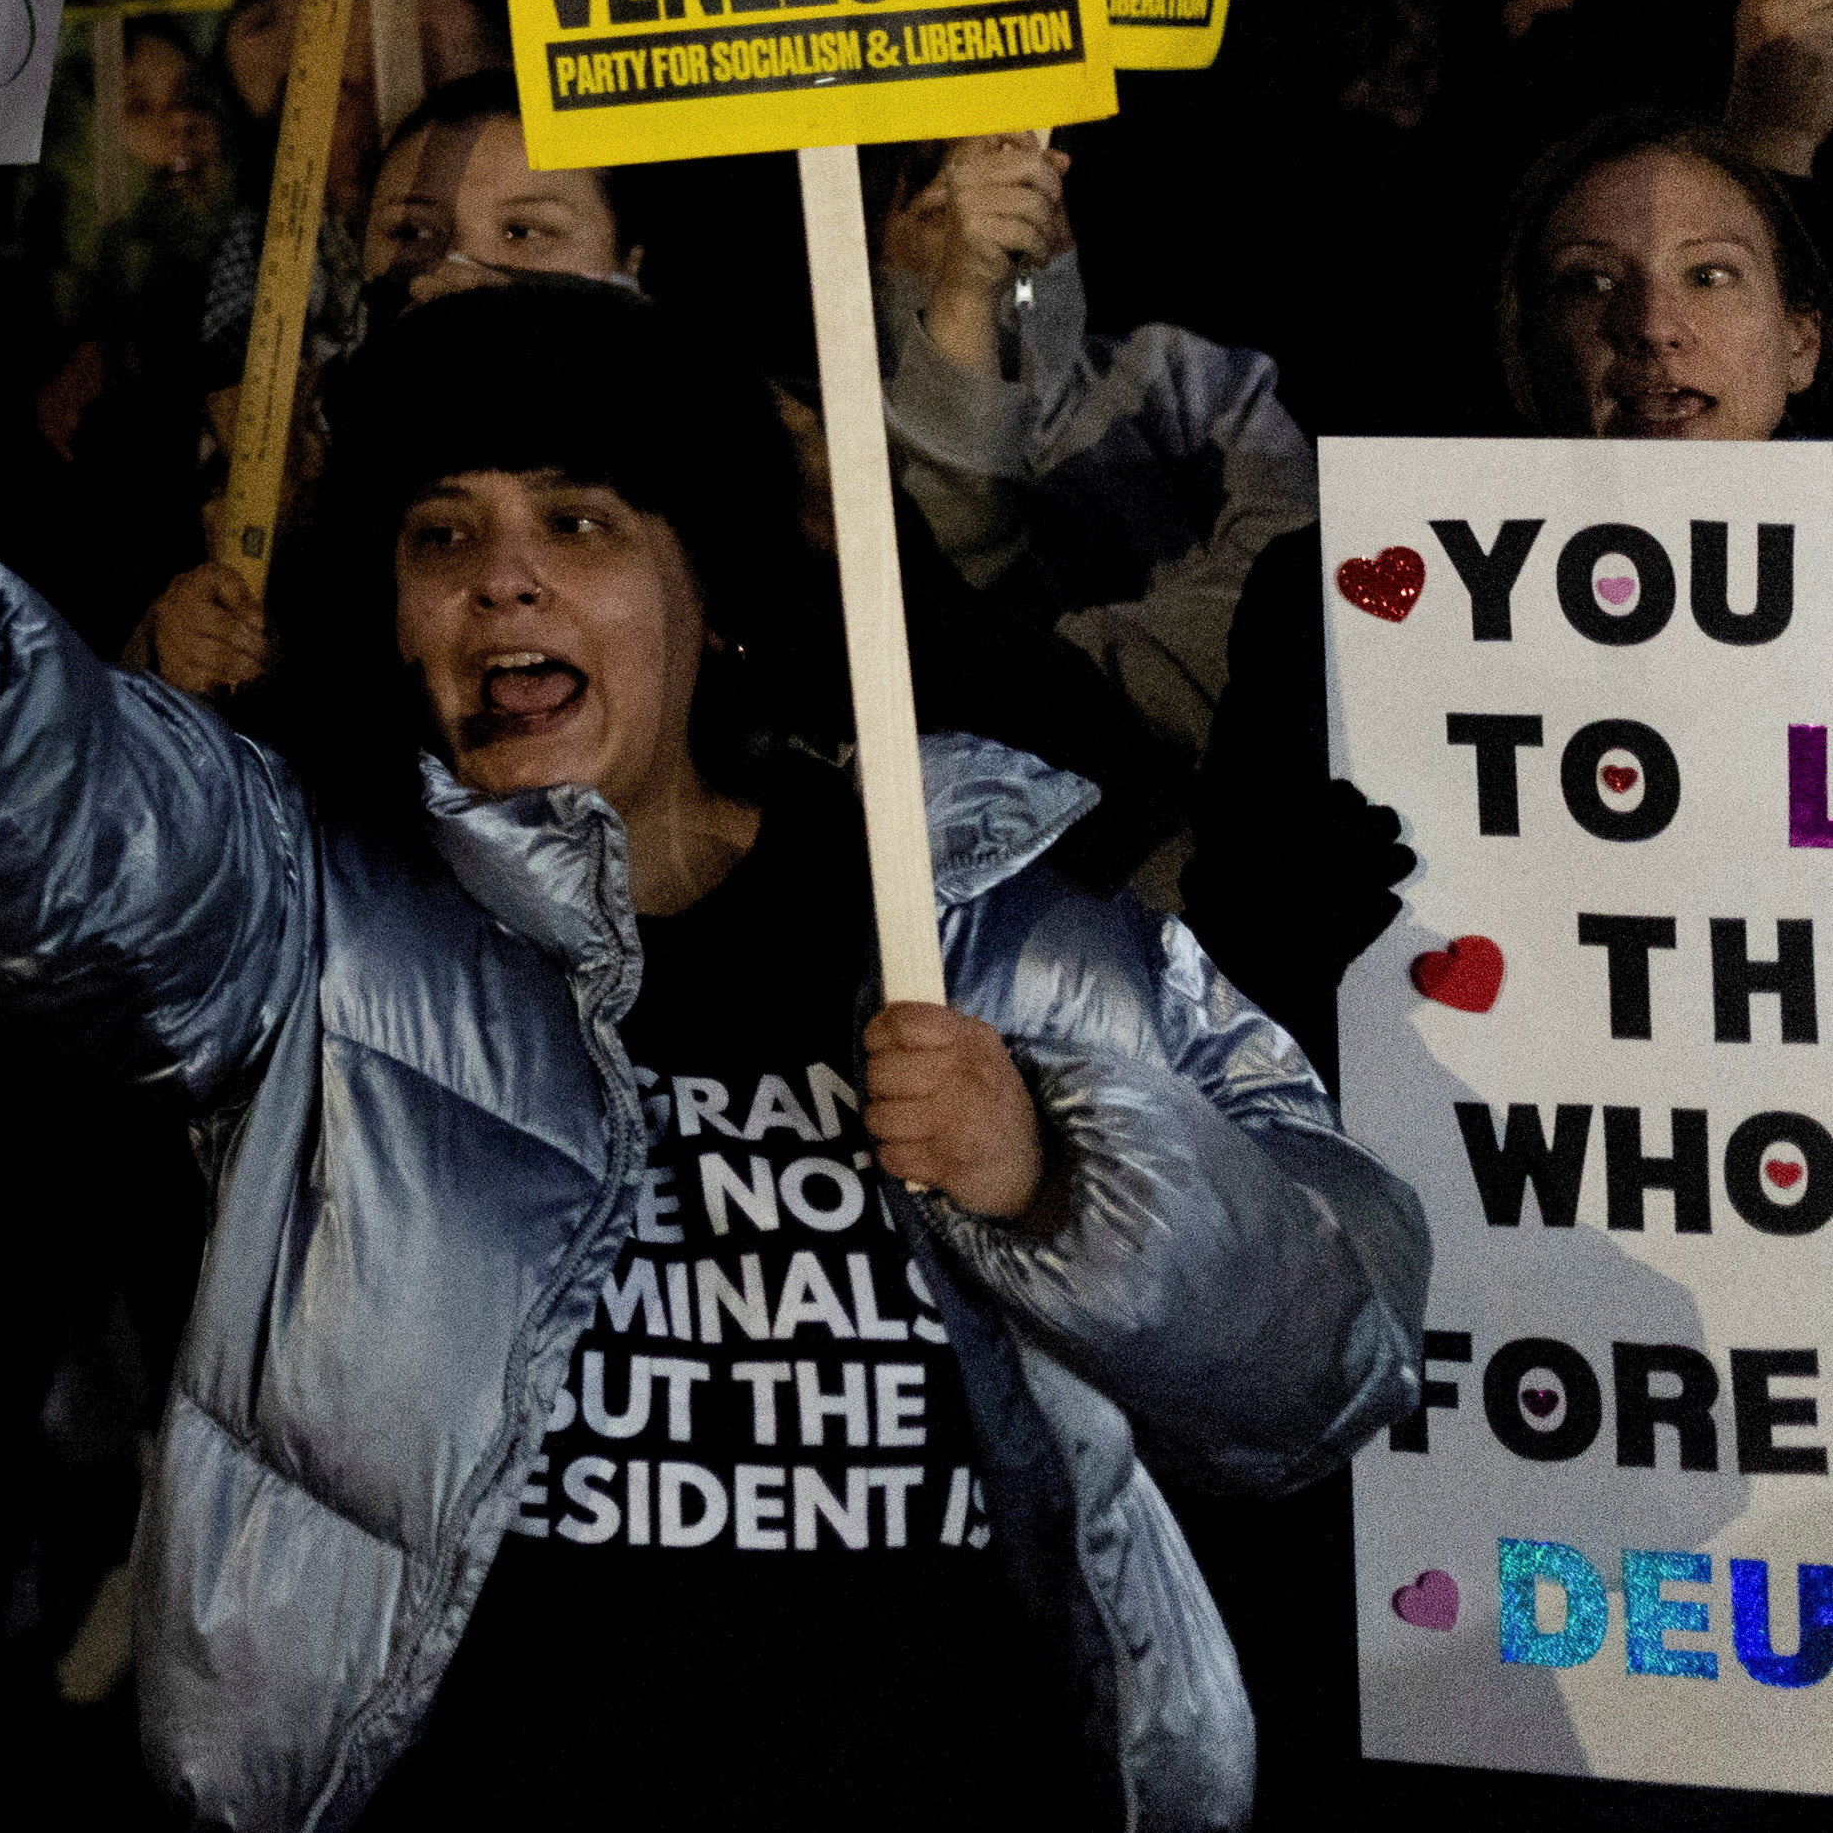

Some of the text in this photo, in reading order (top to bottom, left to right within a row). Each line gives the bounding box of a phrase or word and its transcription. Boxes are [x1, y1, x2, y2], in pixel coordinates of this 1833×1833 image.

[555, 10, 1073, 97] PARTY FOR SOCIALISM & LIBERATION
[1429, 517, 1796, 646] YOU
[1445, 711, 1682, 843] TO
[1579, 912, 1821, 1043] TH
[1454, 1102, 1833, 1235] WHO
[731, 1362, 928, 1448] THE
[511, 1453, 923, 1552] ESIDENT
